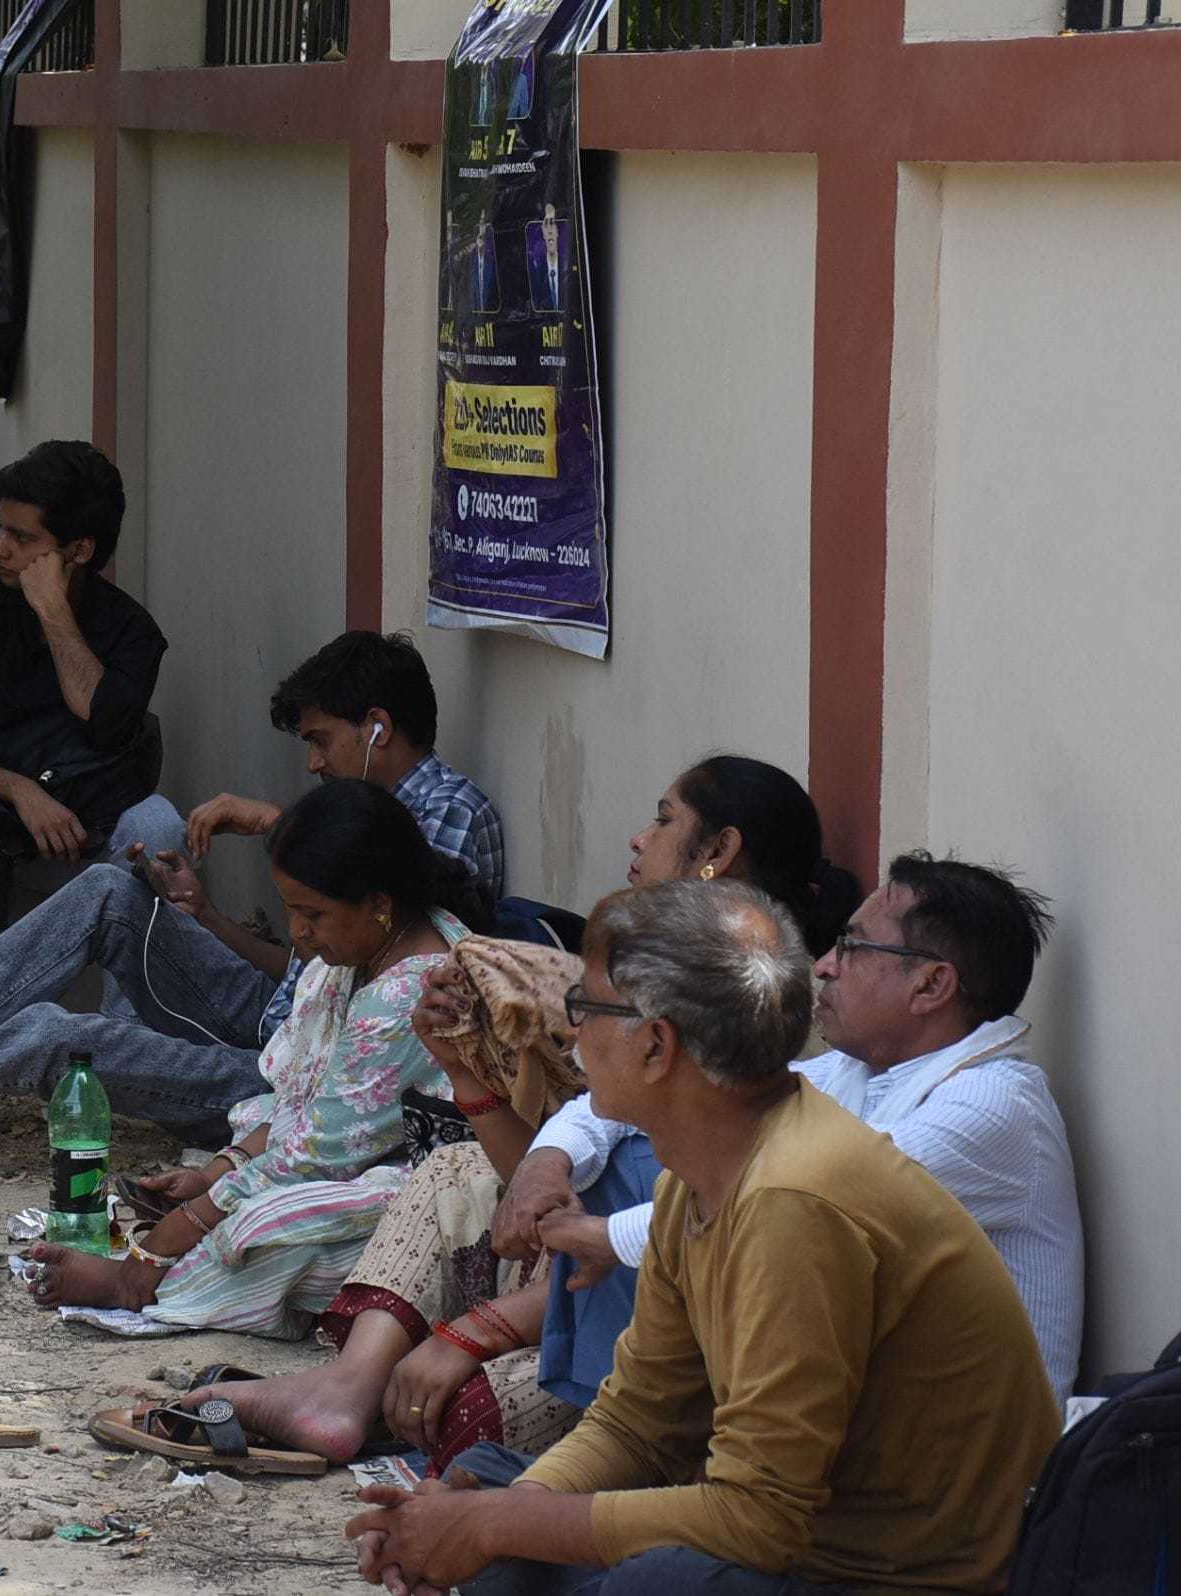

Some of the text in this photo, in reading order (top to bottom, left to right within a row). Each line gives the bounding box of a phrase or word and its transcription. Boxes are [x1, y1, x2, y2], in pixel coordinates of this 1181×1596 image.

[474, 396, 547, 436] Selections
[470, 491, 539, 523] 7406342227
[511, 541, 549, 563] Lucknow
[556, 544, 590, 567] 226024
